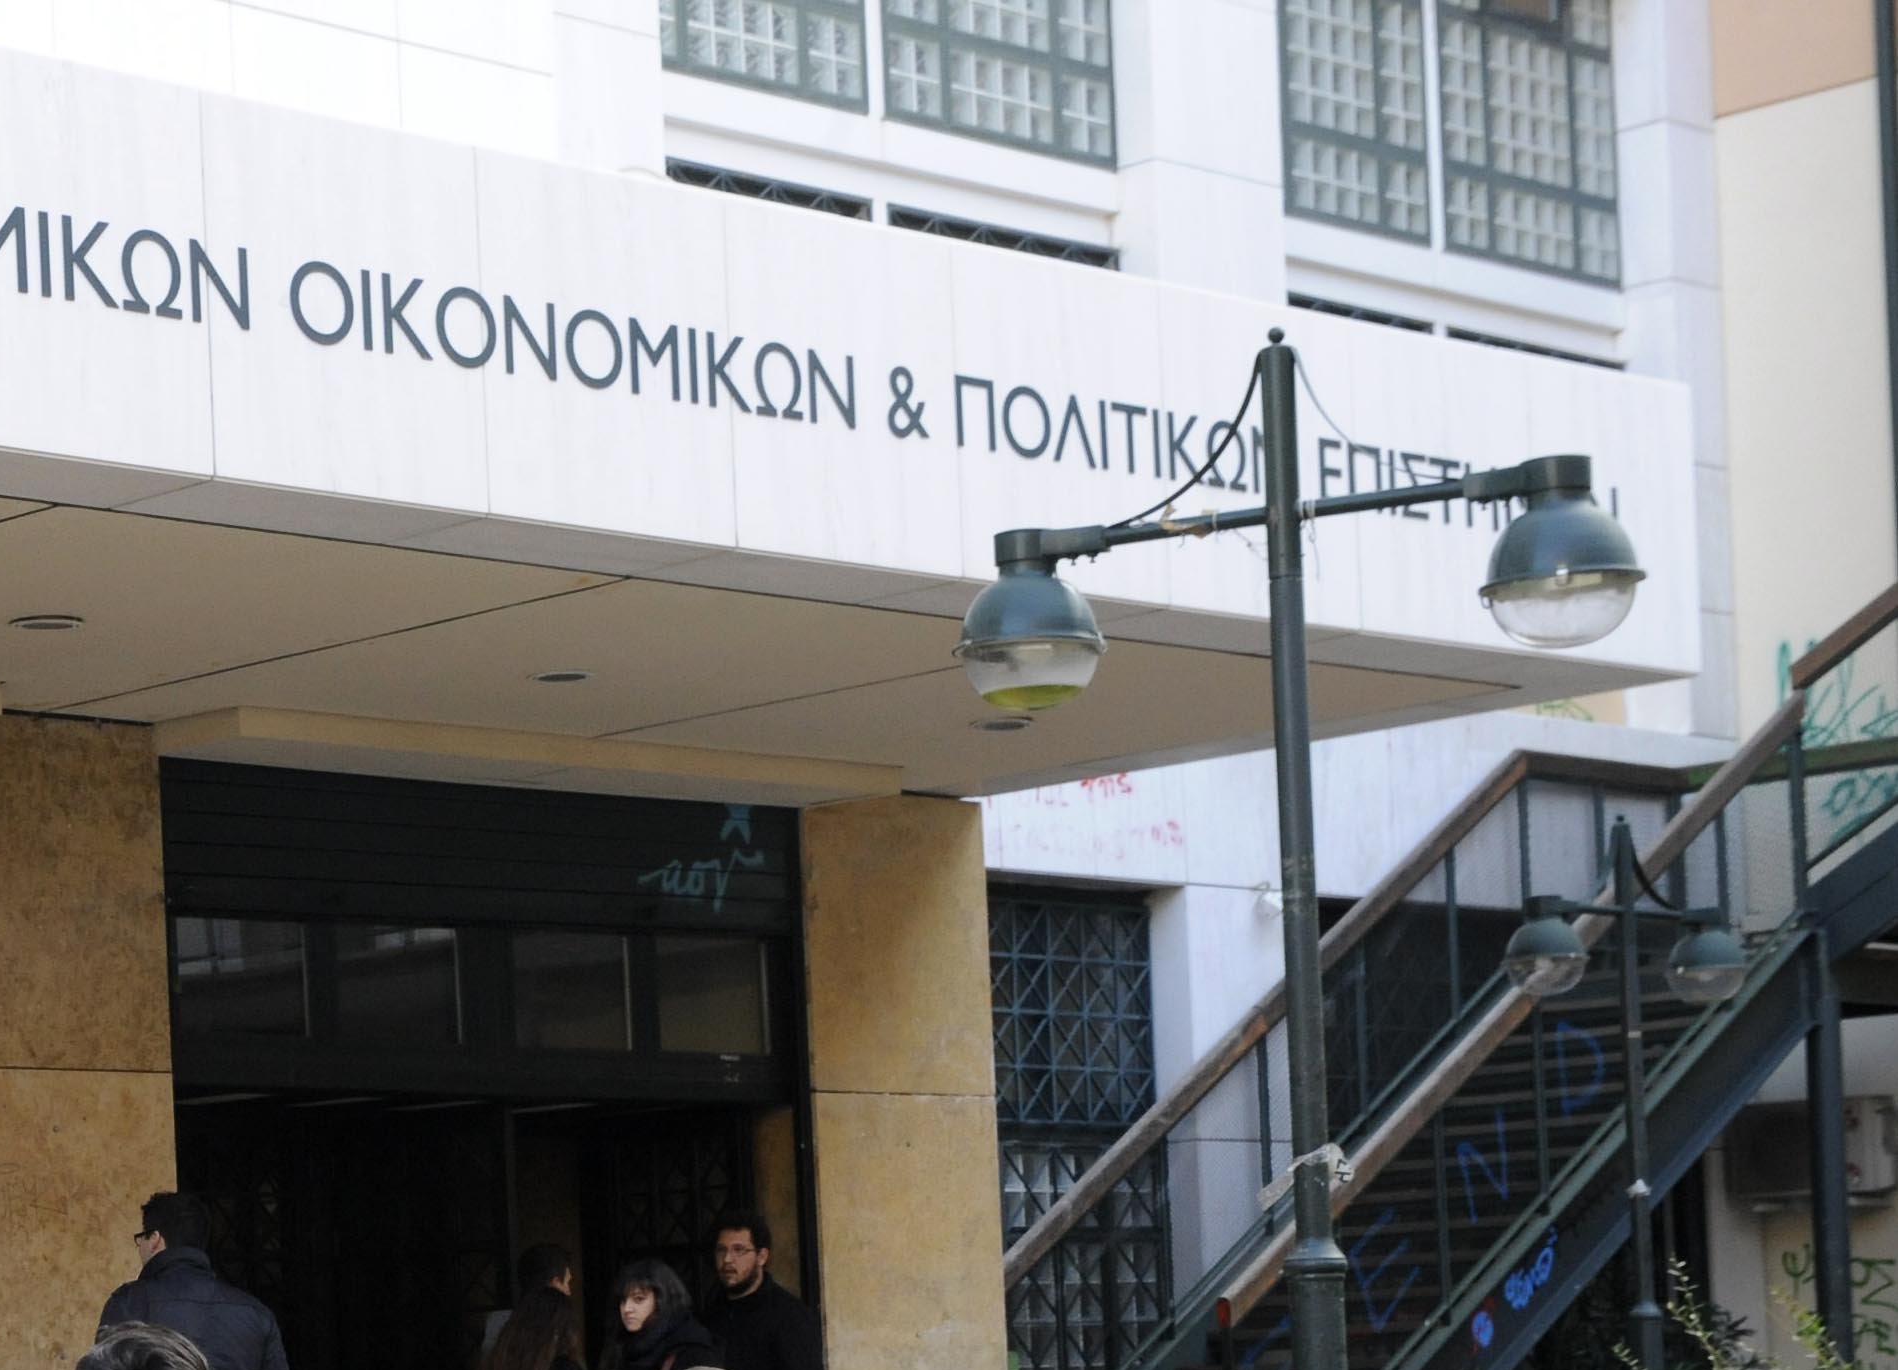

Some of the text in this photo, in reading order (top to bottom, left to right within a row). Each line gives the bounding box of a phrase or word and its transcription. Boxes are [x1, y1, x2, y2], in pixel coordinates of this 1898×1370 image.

[289, 260, 856, 430] ΟΙΚΟΝΟΜΙΚΩΝ
[887, 366, 930, 440] &
[1317, 437, 1619, 532] ΕΠΙΣΤ
